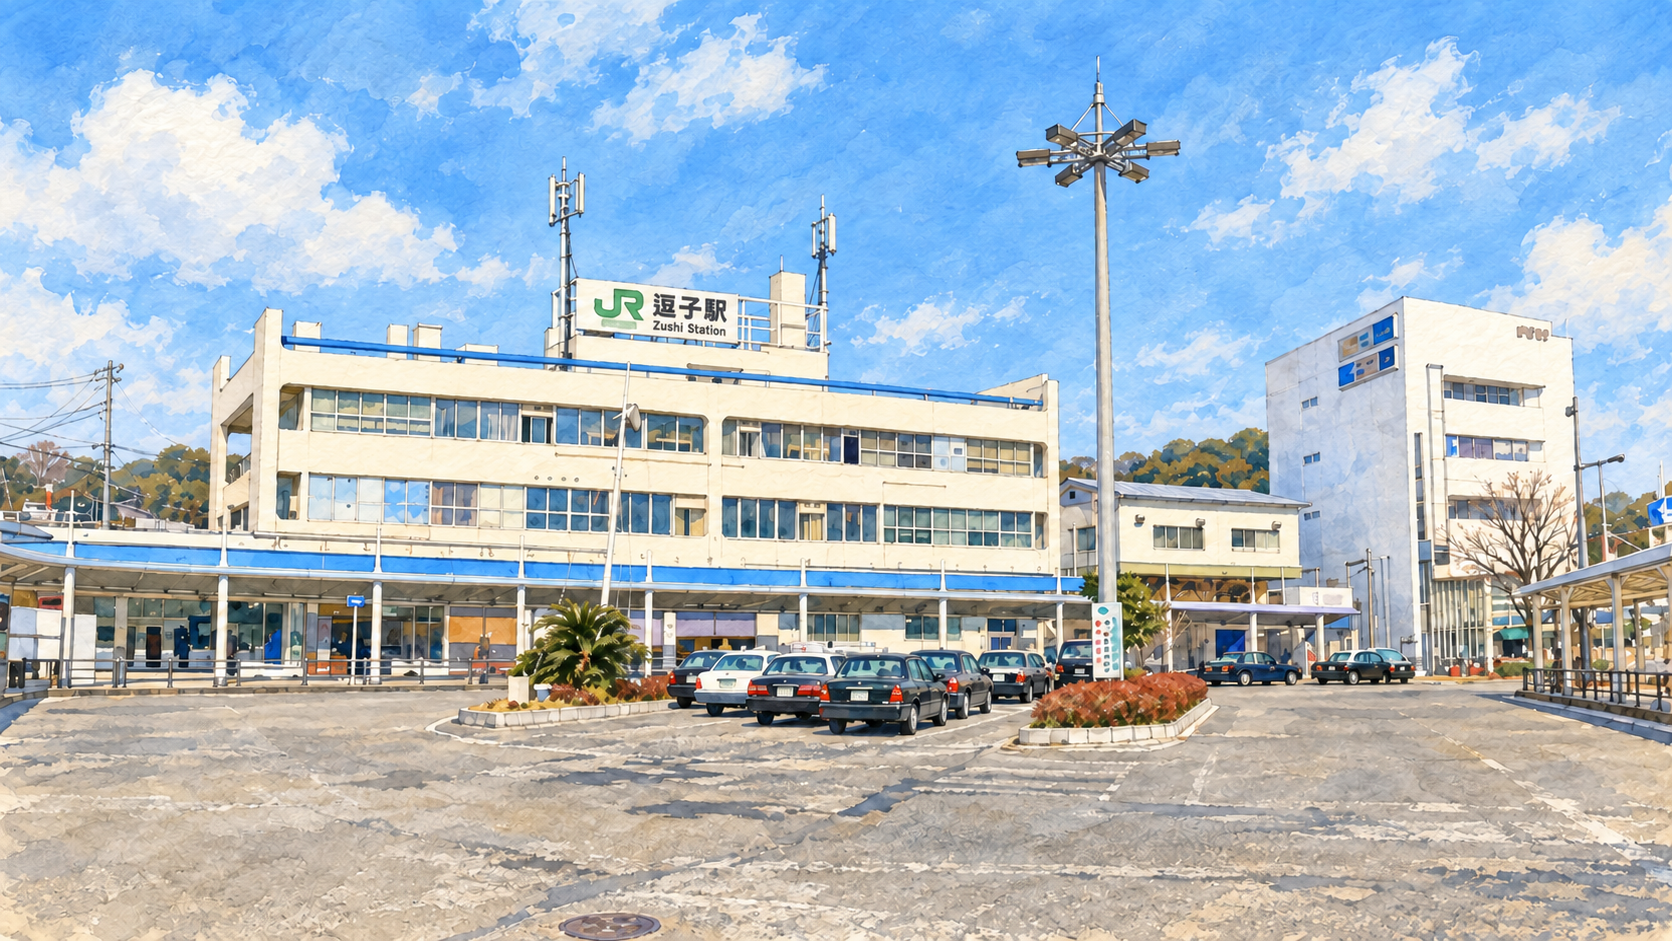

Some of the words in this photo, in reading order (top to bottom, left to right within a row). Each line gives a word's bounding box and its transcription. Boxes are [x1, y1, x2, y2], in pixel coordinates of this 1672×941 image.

[594, 288, 644, 321] JR
[653, 293, 727, 322] 逗子駅
[653, 320, 683, 333] Zushi
[688, 323, 726, 336] Station
